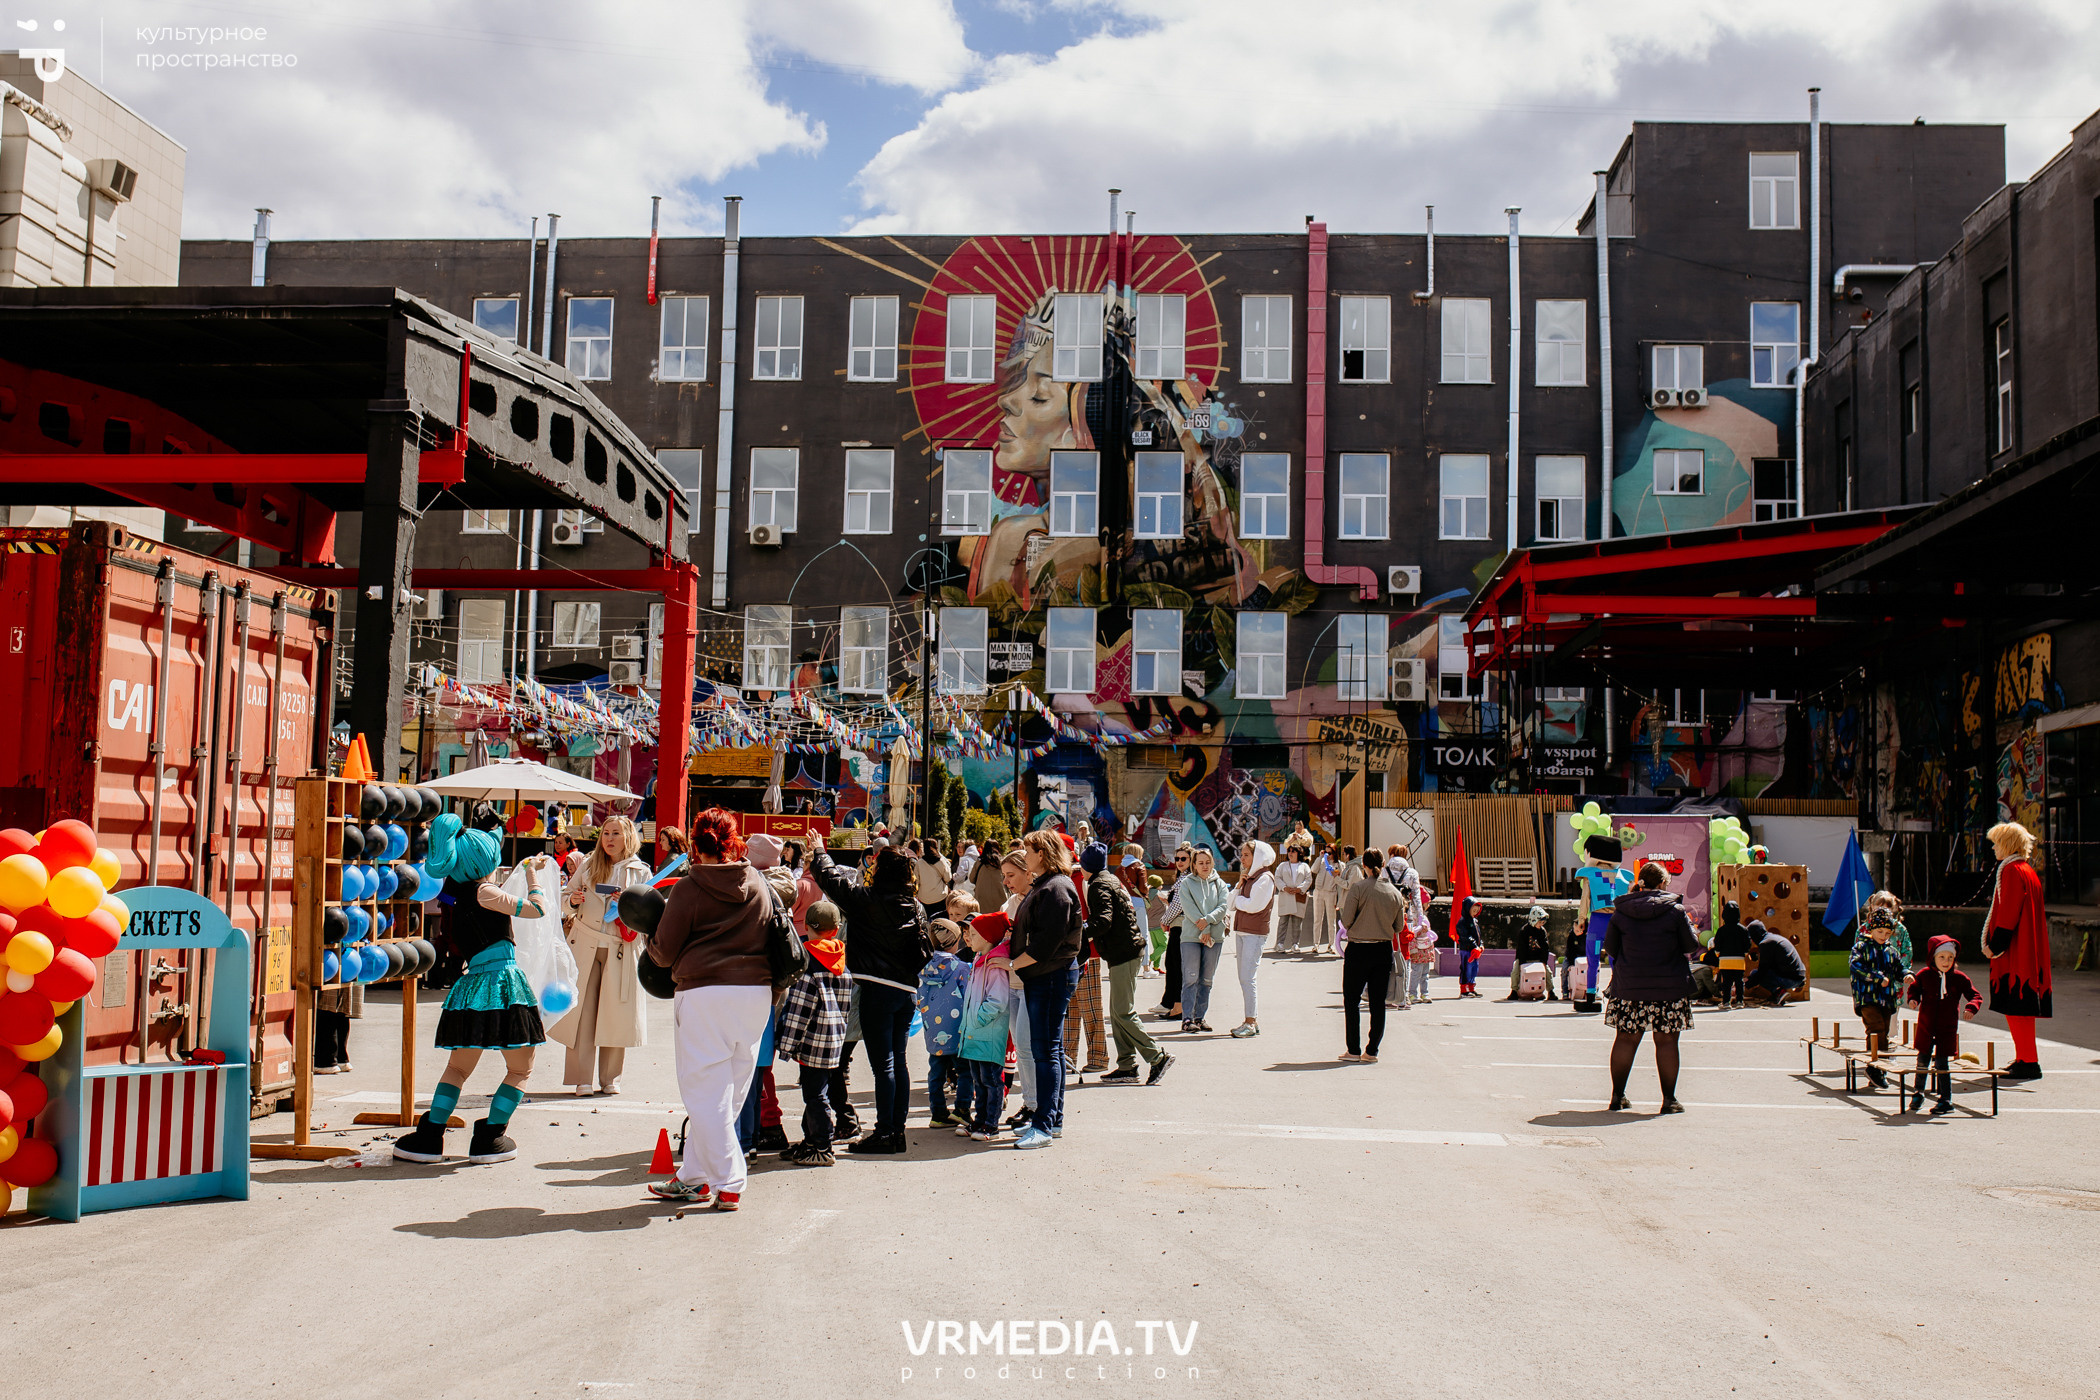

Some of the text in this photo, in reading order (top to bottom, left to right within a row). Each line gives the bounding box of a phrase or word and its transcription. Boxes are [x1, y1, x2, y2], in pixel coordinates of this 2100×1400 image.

[12, 628, 23, 651] 3
[990, 644, 1006, 652] MAN
[1020, 644, 1032, 652] THE
[1011, 652, 1032, 660] MOON
[280, 691, 306, 715] 92258
[1365, 758, 1387, 770] irth
[1648, 853, 1675, 861] BRAWL
[121, 909, 201, 937] CKETS
[267, 928, 291, 947] AUTION
[269, 974, 284, 992] HIGH
